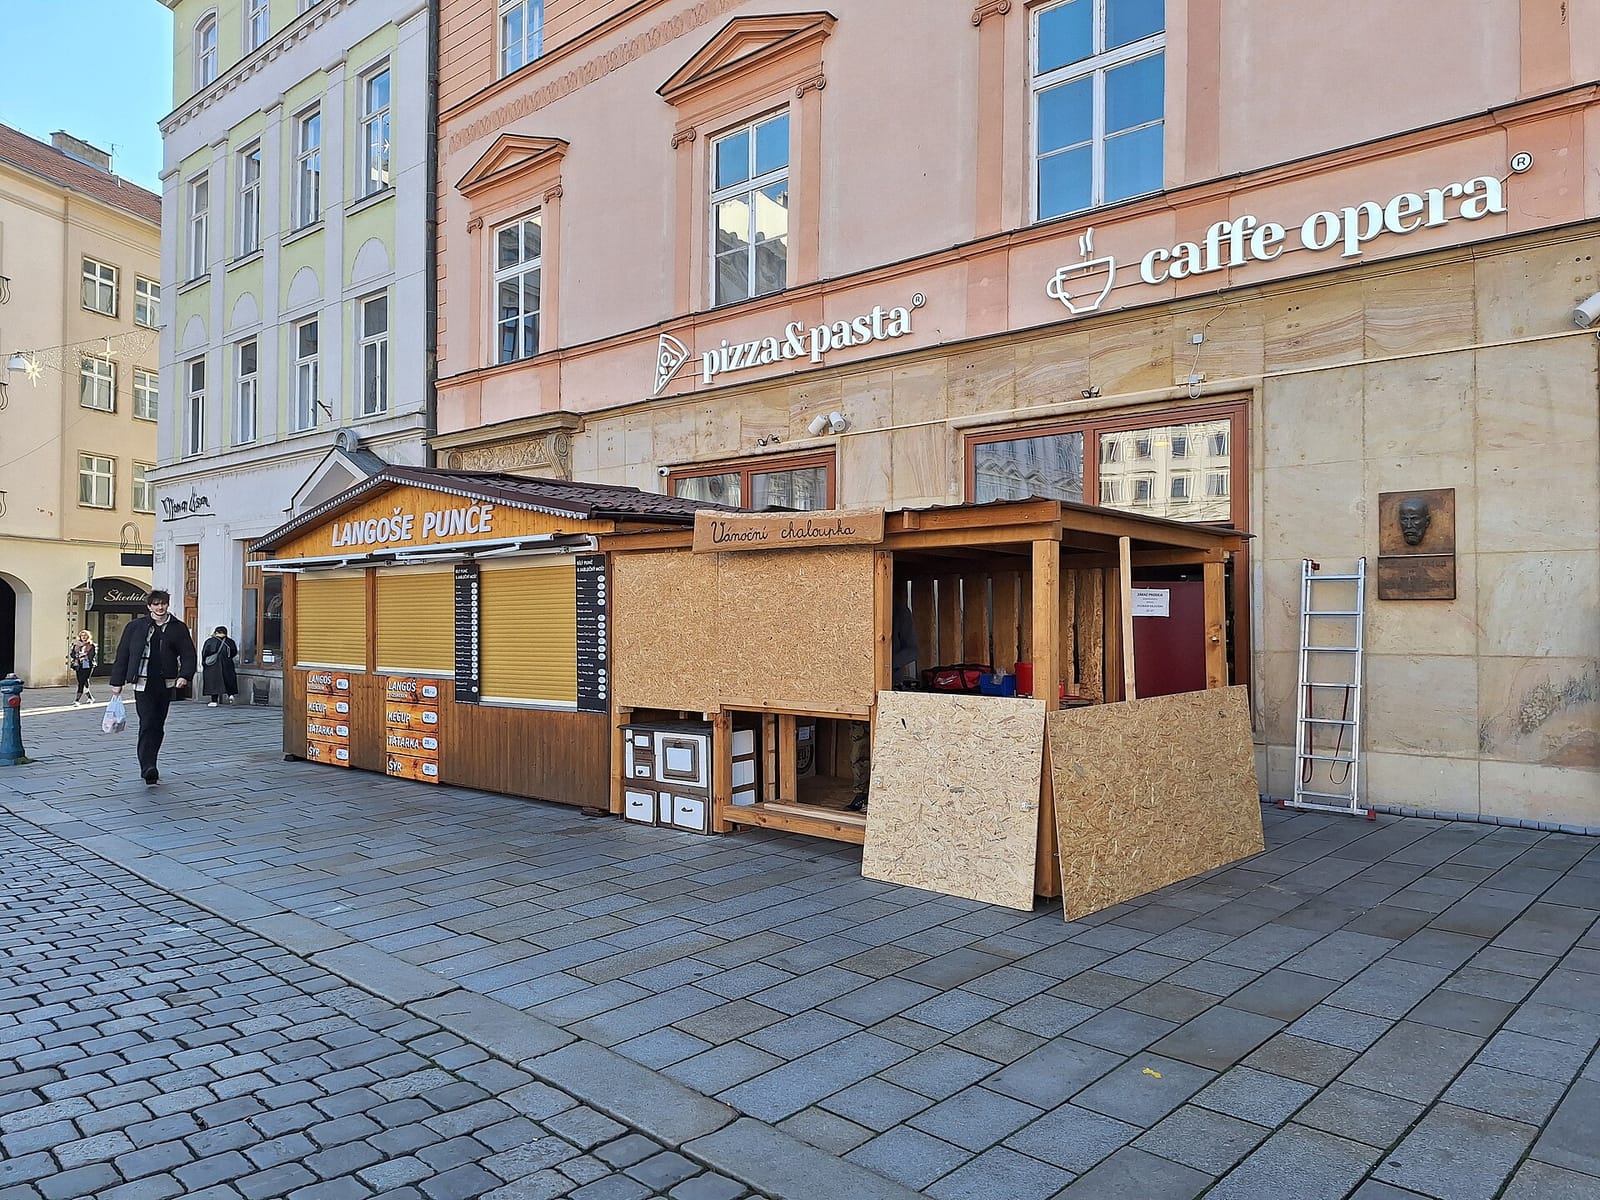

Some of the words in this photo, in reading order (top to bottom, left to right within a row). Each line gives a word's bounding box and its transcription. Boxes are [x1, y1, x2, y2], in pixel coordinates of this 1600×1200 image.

[1139, 215, 1285, 285] caffe
[1301, 175, 1508, 258] opera
[702, 305, 912, 384] pizza&pasta
[331, 507, 415, 547] LANGOŠE
[422, 498, 494, 538] PUNČE
[711, 520, 769, 543] Vánoční
[781, 519, 856, 539] chaloupka
[308, 672, 332, 685] LANGOŠ
[388, 679, 417, 693] LANGOŠ
[308, 701, 327, 713] KEČUP
[387, 710, 411, 723] KEČUP
[308, 723, 334, 736] TATARKA
[387, 735, 419, 750] TATARKA
